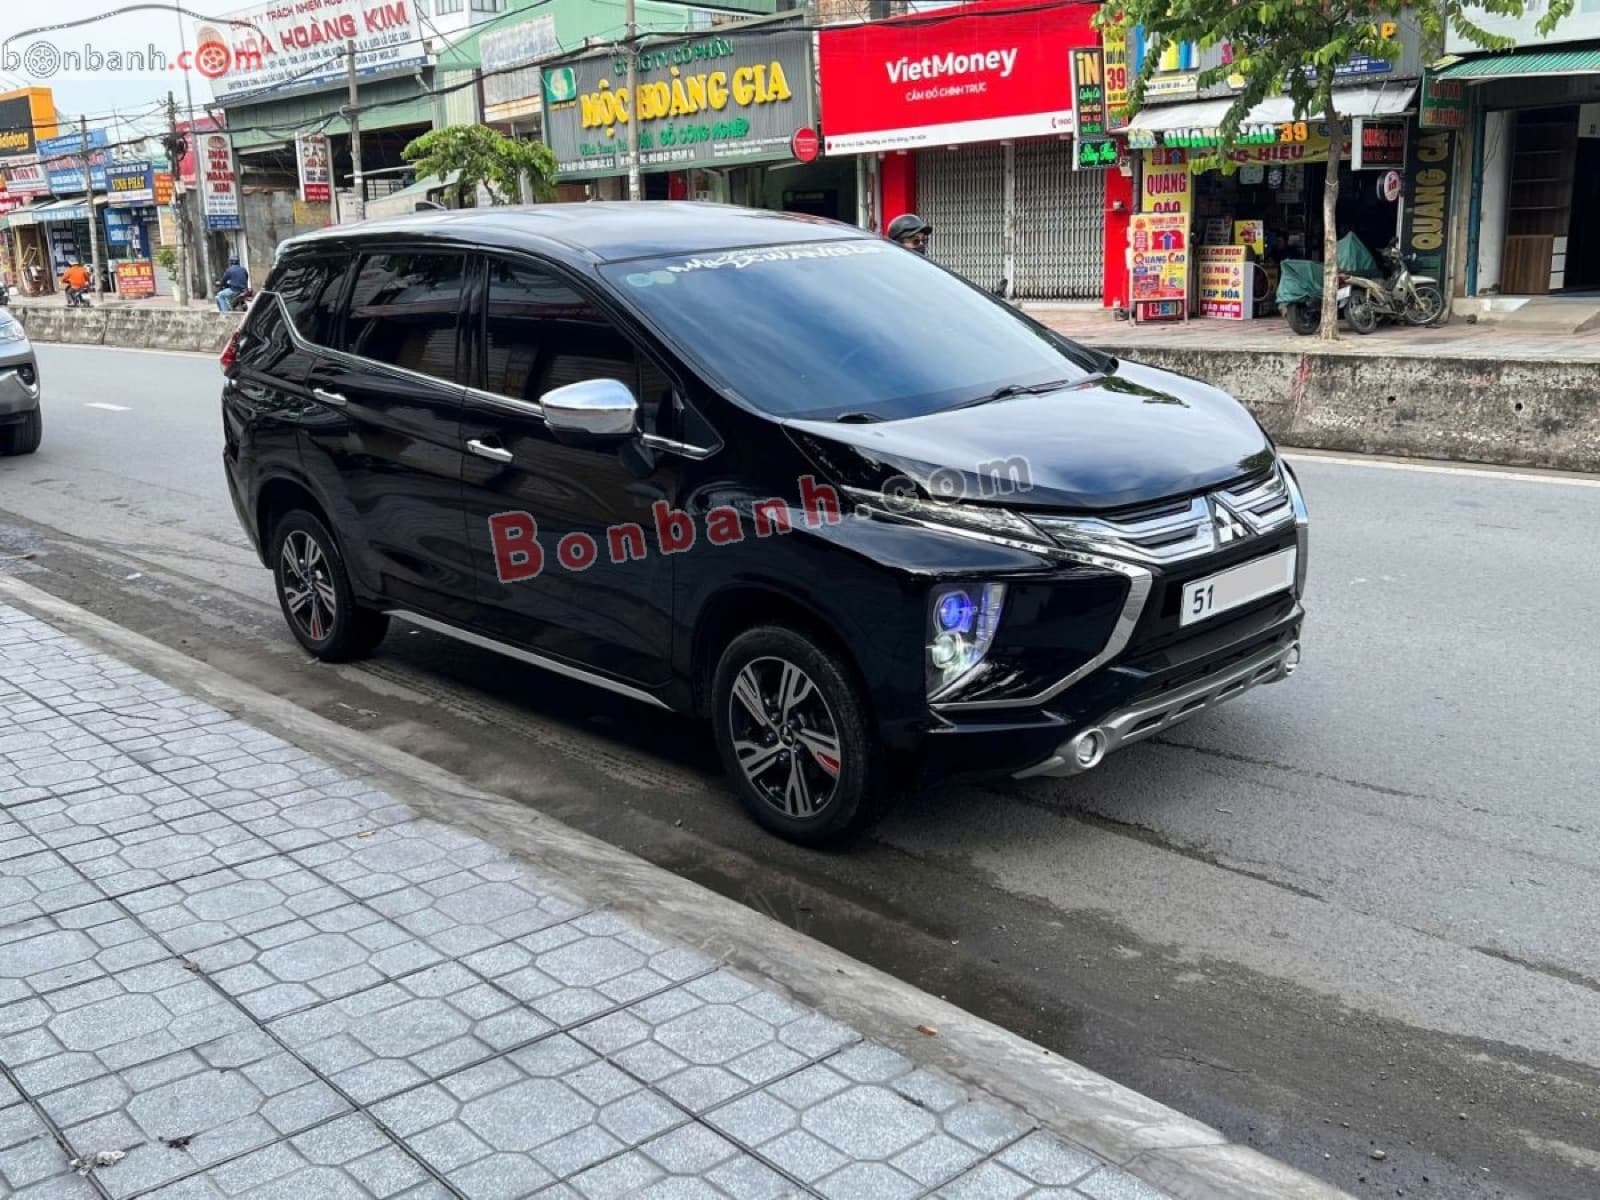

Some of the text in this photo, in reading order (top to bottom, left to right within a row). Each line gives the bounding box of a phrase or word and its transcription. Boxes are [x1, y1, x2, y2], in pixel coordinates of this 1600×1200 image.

[279, 15, 357, 52] HOÀNG
[363, 1, 410, 33] KIM
[886, 48, 1018, 84] VietMoney
[1106, 67, 1126, 91] 39
[580, 61, 792, 138] MỘC HOÀNG GIA
[1279, 121, 1308, 142] 39
[1192, 584, 1215, 614] 51
